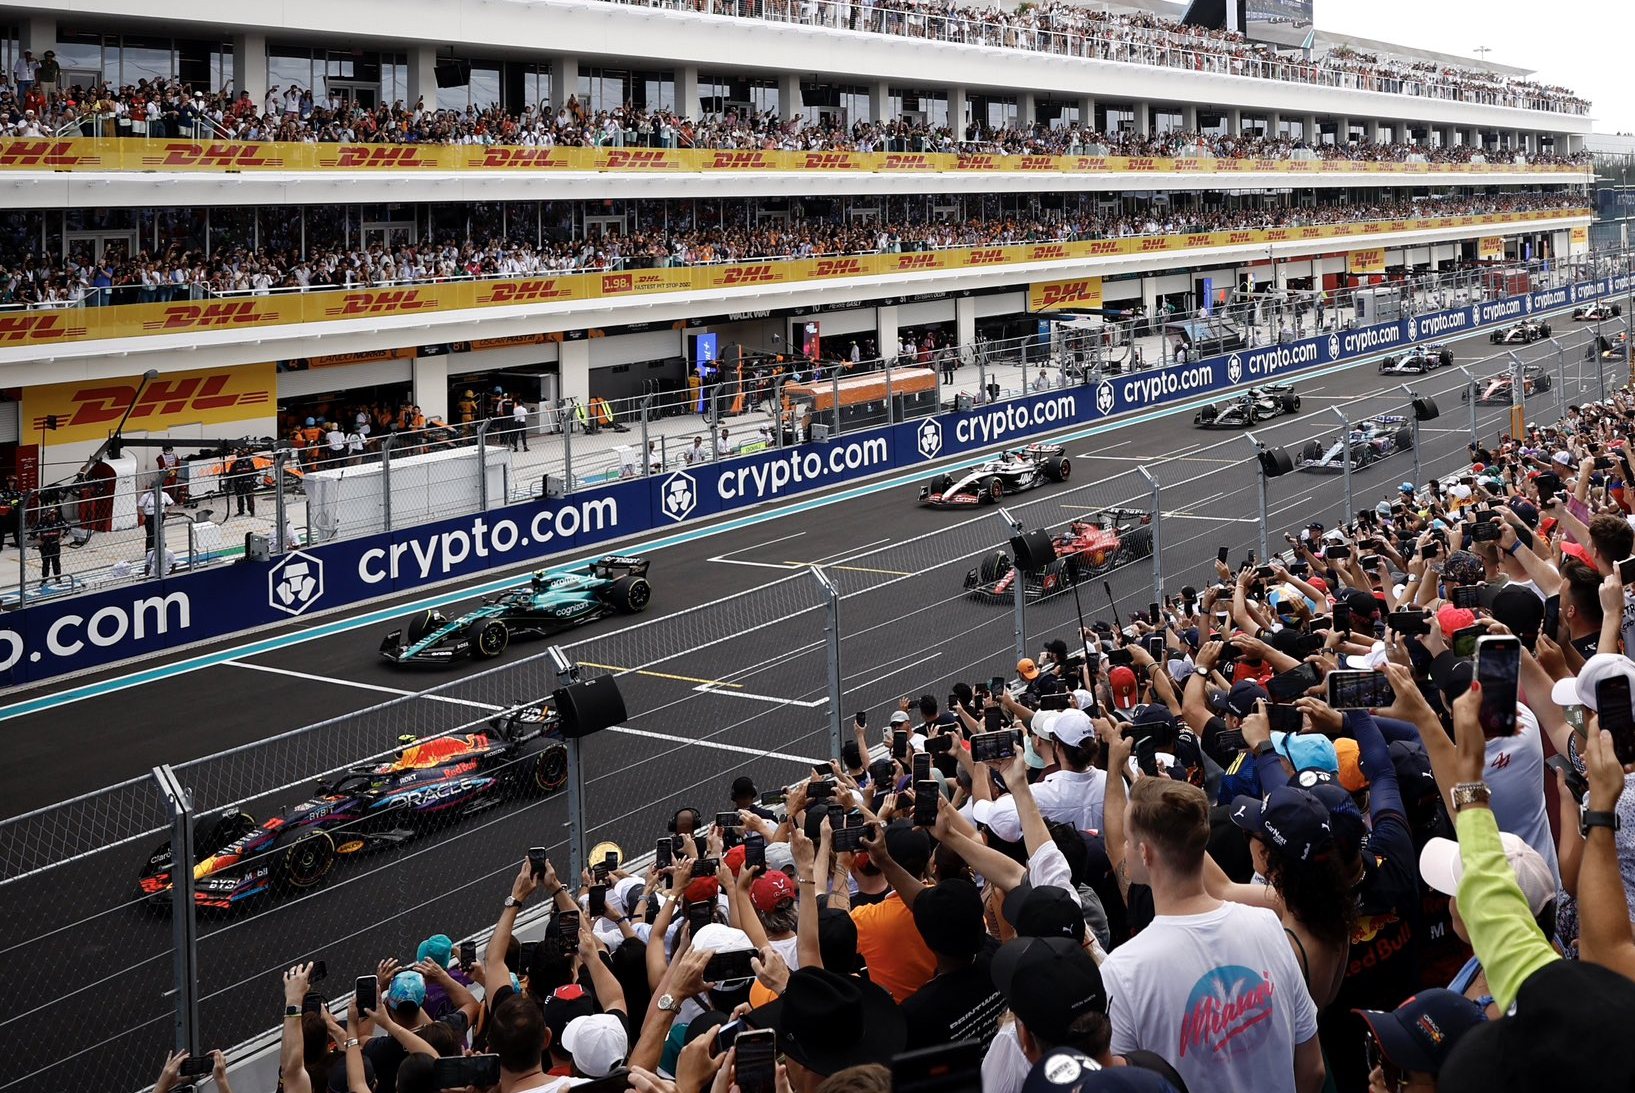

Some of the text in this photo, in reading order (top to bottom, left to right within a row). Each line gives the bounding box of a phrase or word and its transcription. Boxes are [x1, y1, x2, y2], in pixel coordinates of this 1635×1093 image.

[163, 143, 265, 165] DHL
[336, 147, 423, 166] DHL
[483, 149, 555, 166] DHL
[606, 151, 669, 168] DHL
[713, 153, 766, 168] DHL
[804, 154, 851, 168] DHL
[886, 155, 928, 169] DHL
[957, 156, 994, 169] DHL
[1021, 157, 1054, 169] DHL
[1077, 158, 1107, 169] DHL
[1128, 159, 1154, 170] DHL
[1175, 160, 1199, 170] DHL
[1217, 160, 1238, 170] DHL
[1255, 161, 1275, 170] DHL
[1289, 161, 1309, 170] DHL
[1188, 235, 1211, 246] DHL
[1230, 233, 1249, 243] DHL
[1268, 230, 1287, 240] DHL
[1303, 228, 1319, 237] DHL
[1033, 246, 1064, 258] DHL
[1091, 242, 1117, 254] DHL
[1142, 239, 1166, 250] DHL
[898, 254, 937, 269] DHL
[970, 249, 1004, 264] DHL
[1355, 252, 1379, 267] DHL
[723, 265, 777, 284] DHL
[816, 259, 861, 276] DHL
[491, 280, 559, 301] DHL
[1043, 282, 1096, 304] DHL
[342, 290, 423, 314] DHL
[1535, 290, 1566, 308] crypto.com
[162, 302, 261, 328] DHL
[1483, 300, 1520, 320] crypto.com
[1421, 312, 1465, 334] crypto.com
[1345, 326, 1399, 353] crypto.com
[1249, 342, 1317, 373] crypto.com
[1124, 366, 1212, 404] crypto.com
[69, 374, 240, 426] DHL
[956, 395, 1075, 442] crypto.com
[718, 436, 887, 499] crypto.com
[358, 497, 617, 584] crypto.com
[551, 576, 580, 588] aramco
[556, 601, 589, 617] cognizant
[444, 758, 478, 779] Red Bull
[388, 778, 473, 809] ORACLE
[1180, 970, 1275, 1058] Miami
